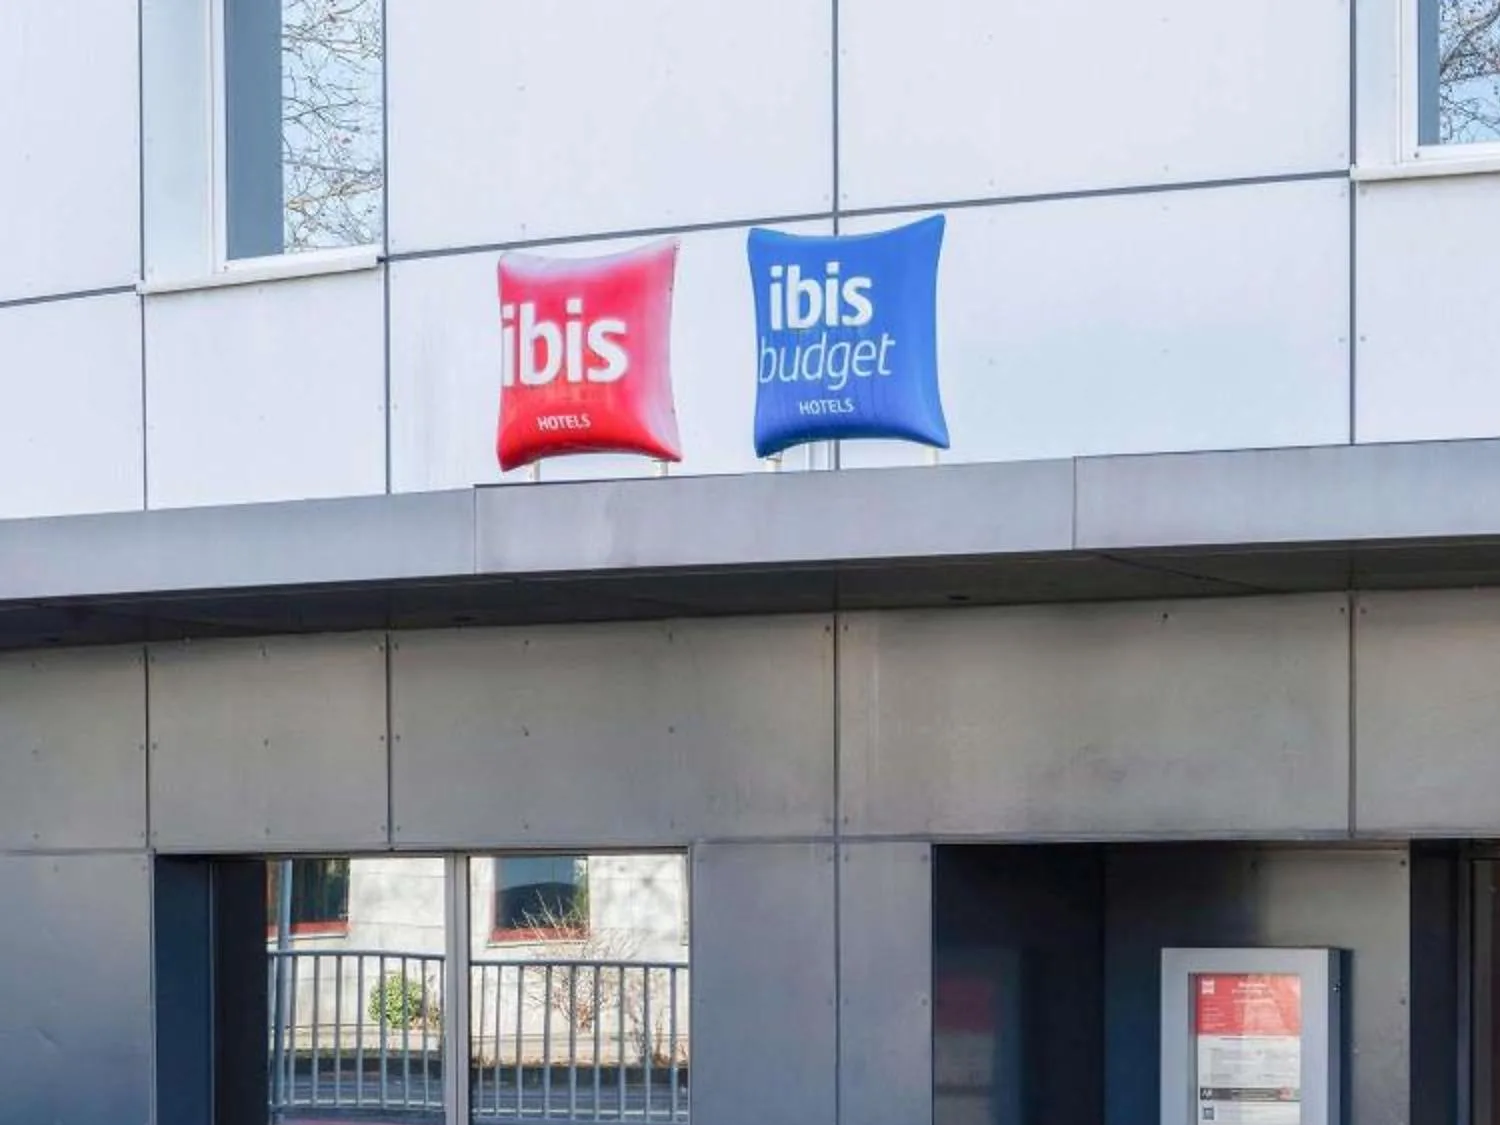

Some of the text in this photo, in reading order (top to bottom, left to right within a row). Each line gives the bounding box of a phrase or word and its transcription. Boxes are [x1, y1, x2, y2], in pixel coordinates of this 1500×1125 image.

[769, 261, 873, 331] ibis
[501, 298, 629, 387] ibis
[759, 332, 896, 391] budget
[536, 413, 592, 431] HOTELS
[799, 397, 855, 414] HOTELS
